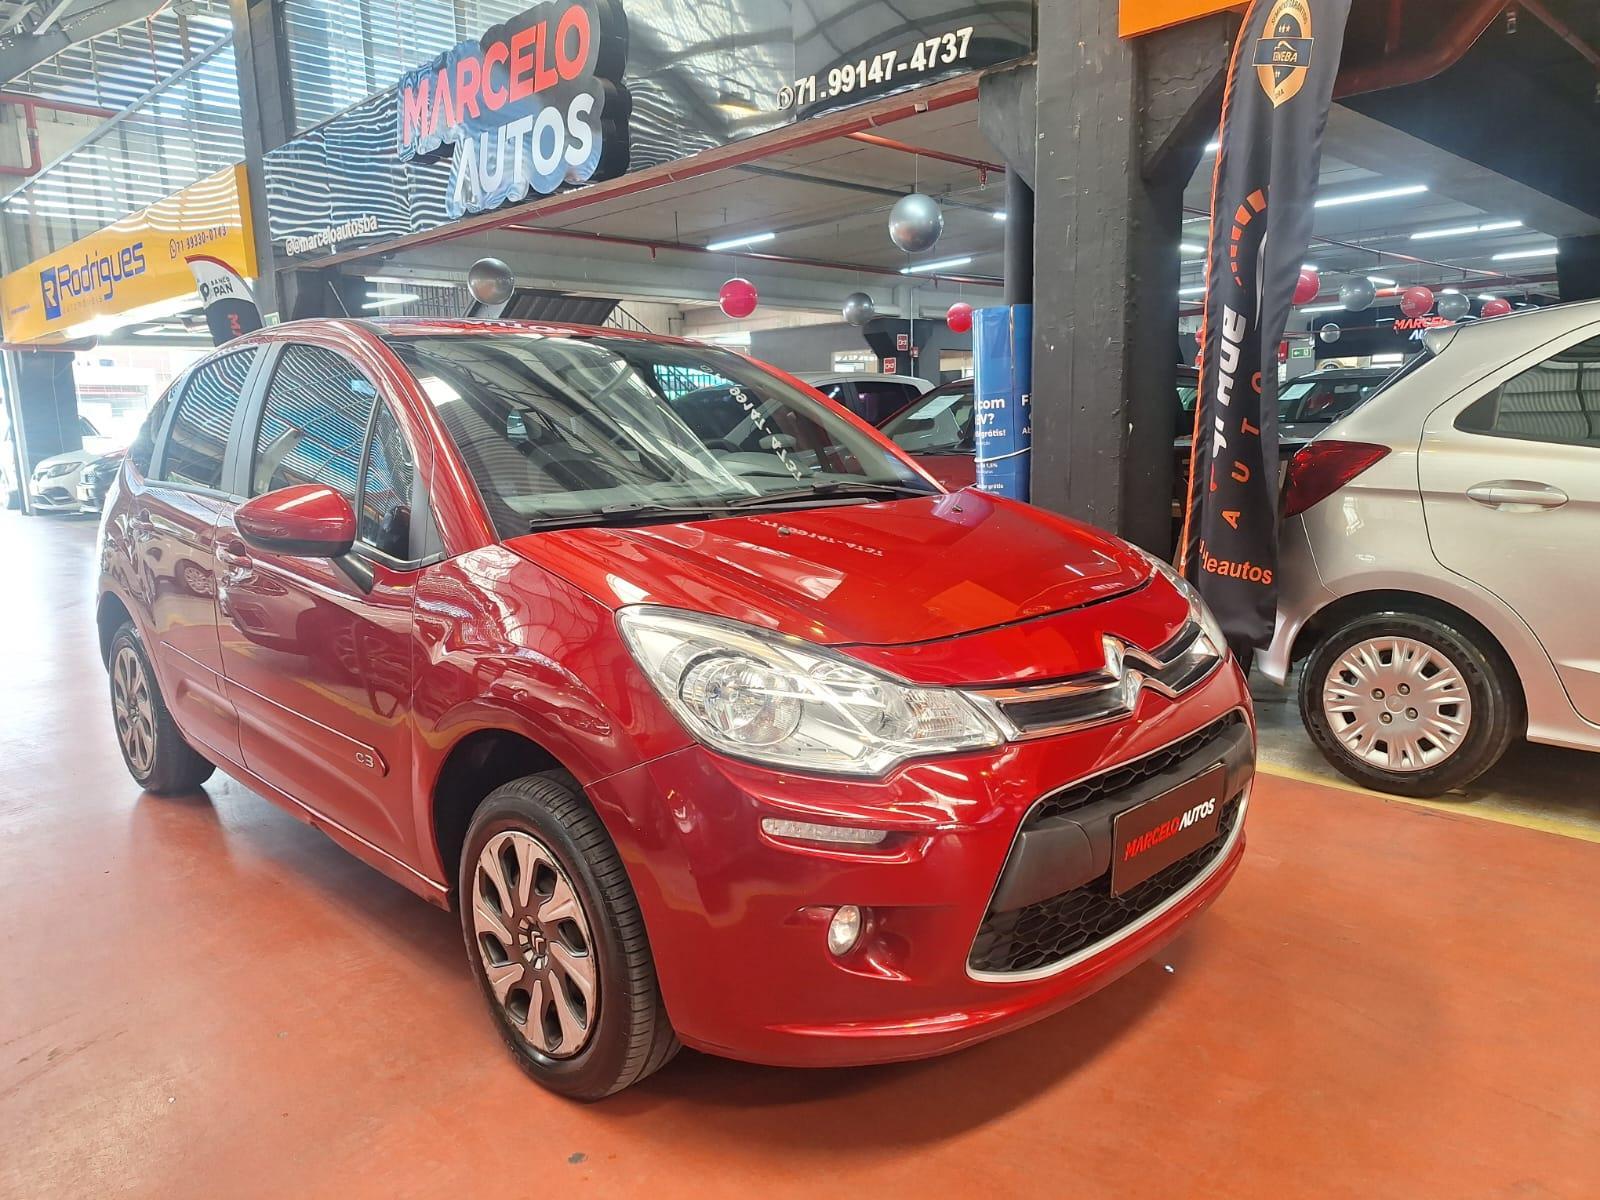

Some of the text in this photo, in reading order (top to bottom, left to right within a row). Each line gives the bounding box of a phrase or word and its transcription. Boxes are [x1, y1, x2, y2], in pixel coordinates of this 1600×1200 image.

[402, 4, 591, 146] MARCELO
[795, 26, 974, 106] 71.99147-4737
[453, 92, 595, 203] AUTOS
[58, 242, 146, 300] Rodrigues
[213, 282, 234, 297] PAN
[355, 752, 375, 768] C3
